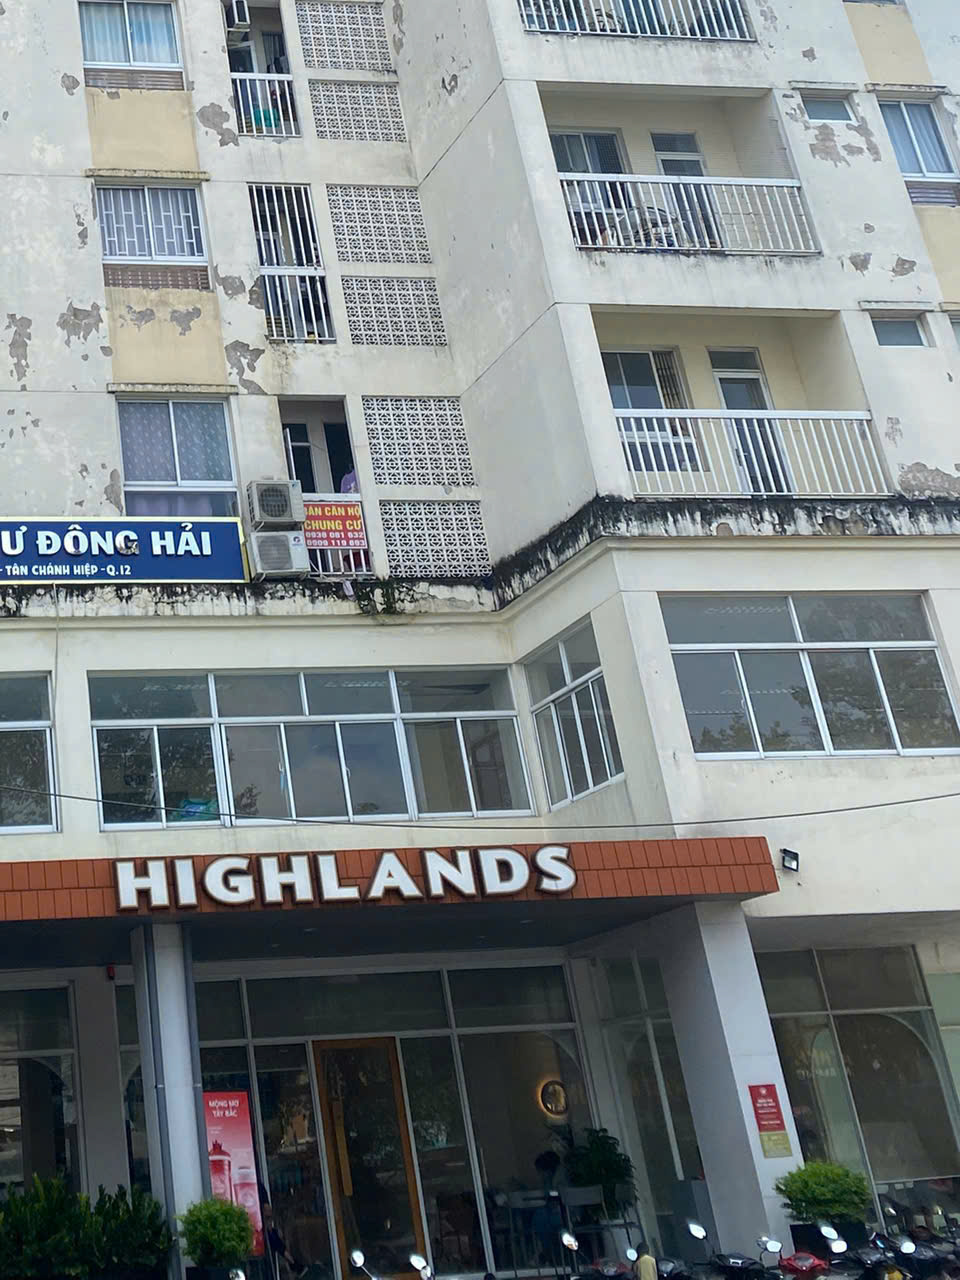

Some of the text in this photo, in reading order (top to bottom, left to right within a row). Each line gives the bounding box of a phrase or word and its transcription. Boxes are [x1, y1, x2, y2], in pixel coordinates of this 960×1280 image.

[304, 520, 342, 530] CHUNG
[36, 524, 139, 556] ĐÔNG
[150, 522, 212, 556] HẢI
[5, 563, 29, 576] TÂN
[31, 562, 70, 576] CHÁNH
[73, 563, 98, 577] HIỆP
[115, 844, 578, 910] HIGHLANDS
